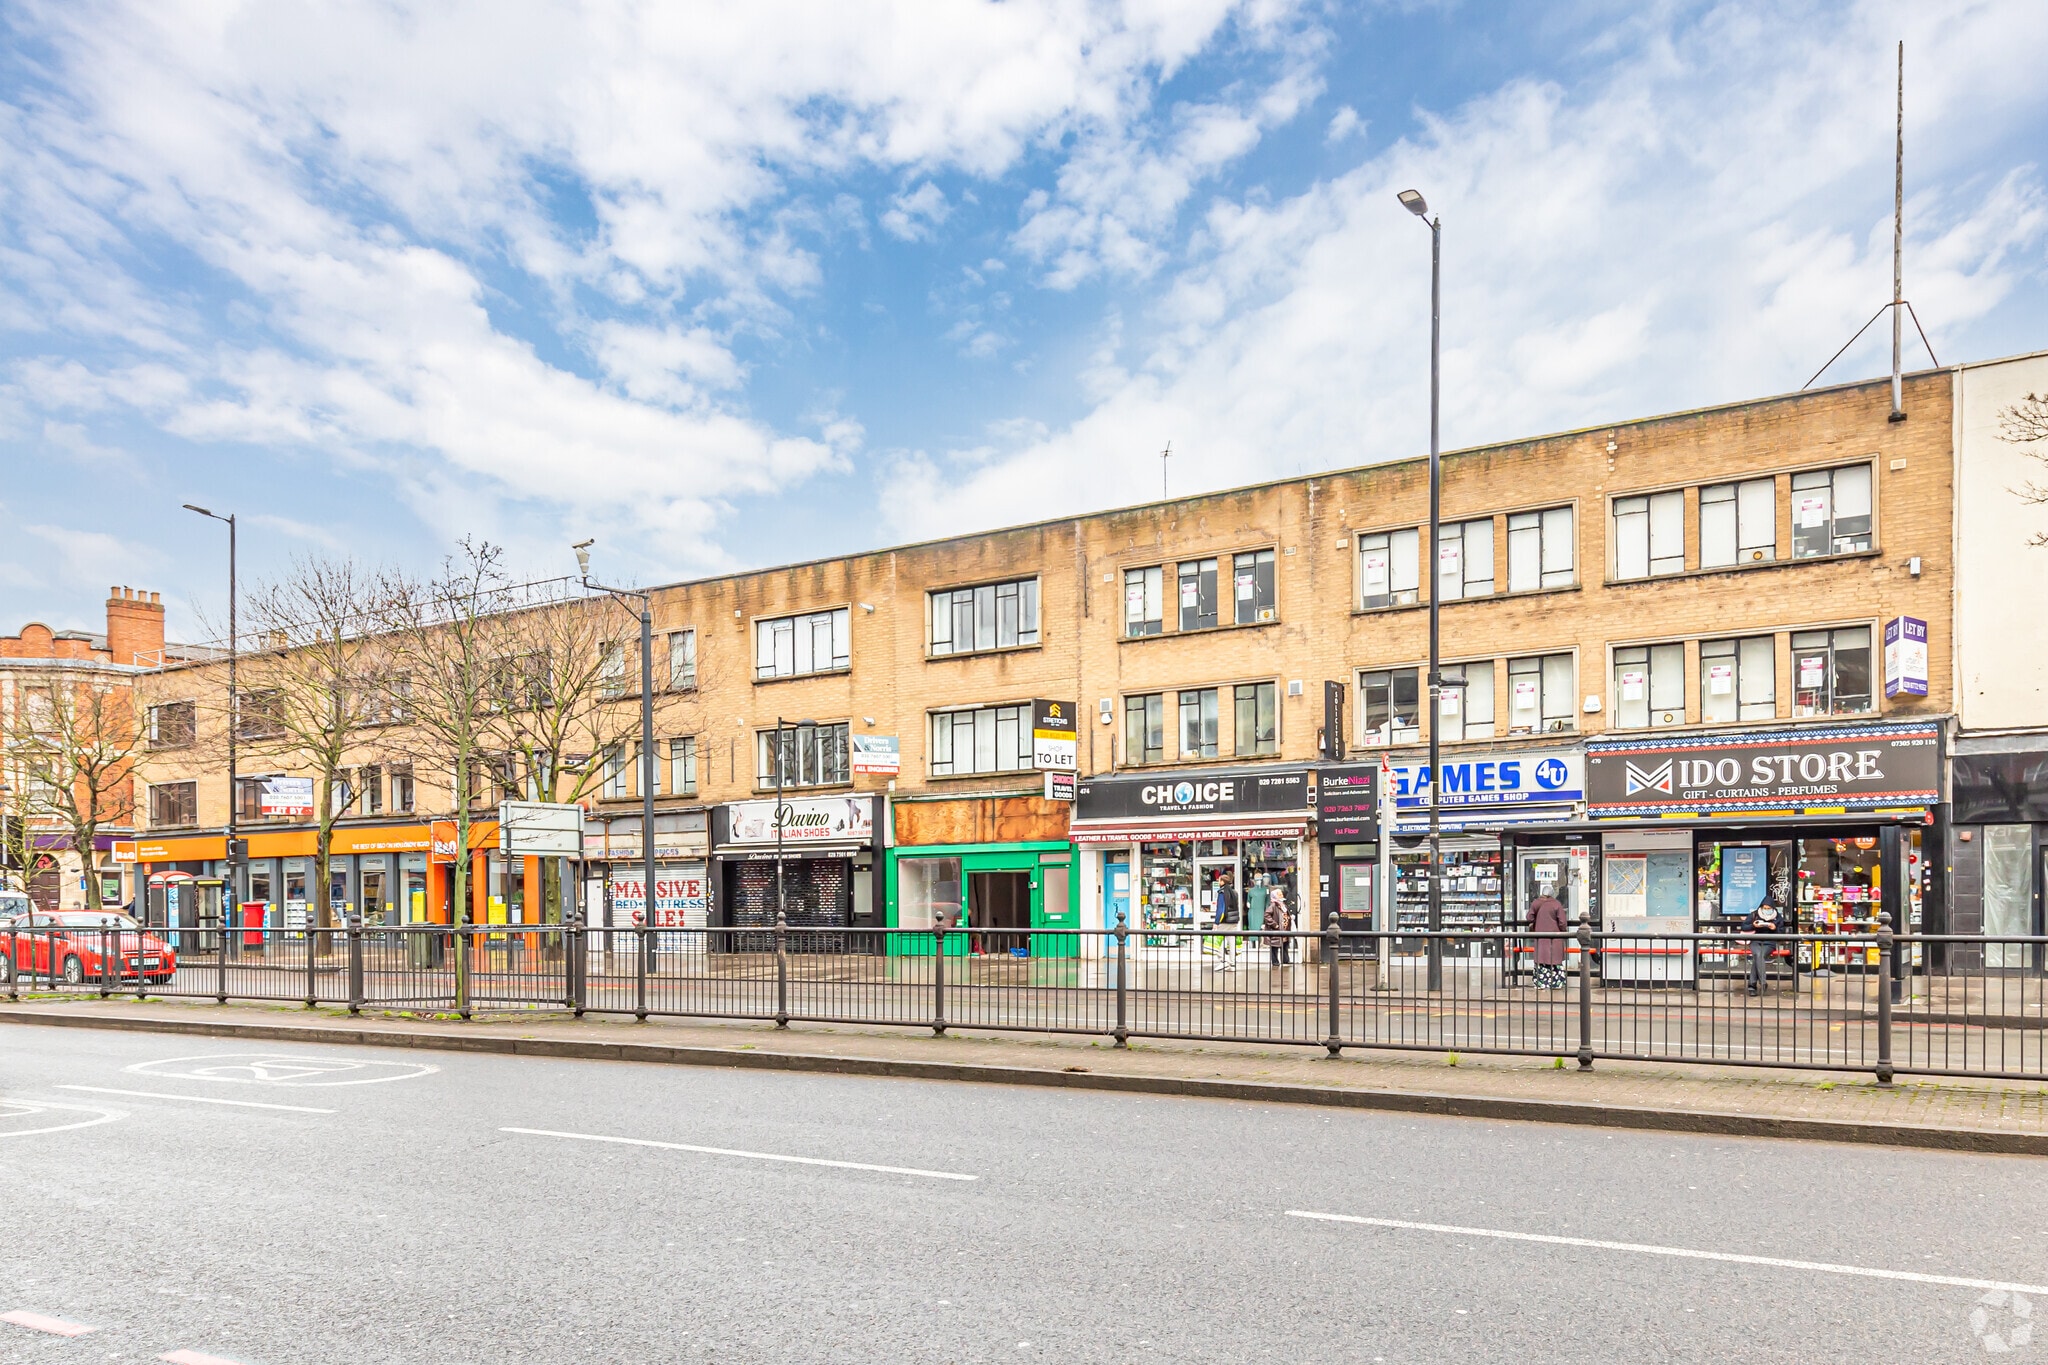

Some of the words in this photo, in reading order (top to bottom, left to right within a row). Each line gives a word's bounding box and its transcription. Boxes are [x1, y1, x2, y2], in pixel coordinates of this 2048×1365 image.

[1905, 621, 1917, 636] LET
[1917, 625, 1926, 638] BY
[1037, 753, 1052, 763] TO
[1054, 754, 1073, 765] LET
[867, 765, 899, 773] ENQUIRIES
[1750, 749, 1885, 785] STORE
[1259, 778, 1270, 786] 020
[1391, 761, 1521, 795] GAMES
[1536, 759, 1566, 786] 4U
[1141, 781, 1235, 805] CHOICE
[1683, 789, 1708, 799] GIFT
[1715, 787, 1769, 798] CURTAINS
[1777, 784, 1838, 795] PERFUMES
[1419, 795, 1465, 805] COPUTER
[1468, 793, 1500, 803] GAMES
[1503, 792, 1529, 802] SHOP
[271, 806, 286, 815] LET
[290, 806, 303, 815] BY
[770, 803, 830, 828] Davino
[1324, 805, 1336, 813] 020
[804, 827, 831, 838] SHOES
[1074, 834, 1102, 842] LEATHER
[1130, 833, 1152, 841] GOODS
[1178, 831, 1195, 839] CAPS
[1195, 831, 1202, 839] &
[1202, 830, 1227, 838] MOBILE
[1228, 829, 1251, 837] PHONE
[1251, 828, 1300, 837] ACCESSORIES
[434, 840, 457, 855] B&Q
[116, 851, 136, 860] B&Q
[747, 853, 773, 861] Davino
[614, 879, 701, 899] MASIVE
[644, 899, 705, 909] ATTRESS
[631, 910, 685, 928] SLE!
